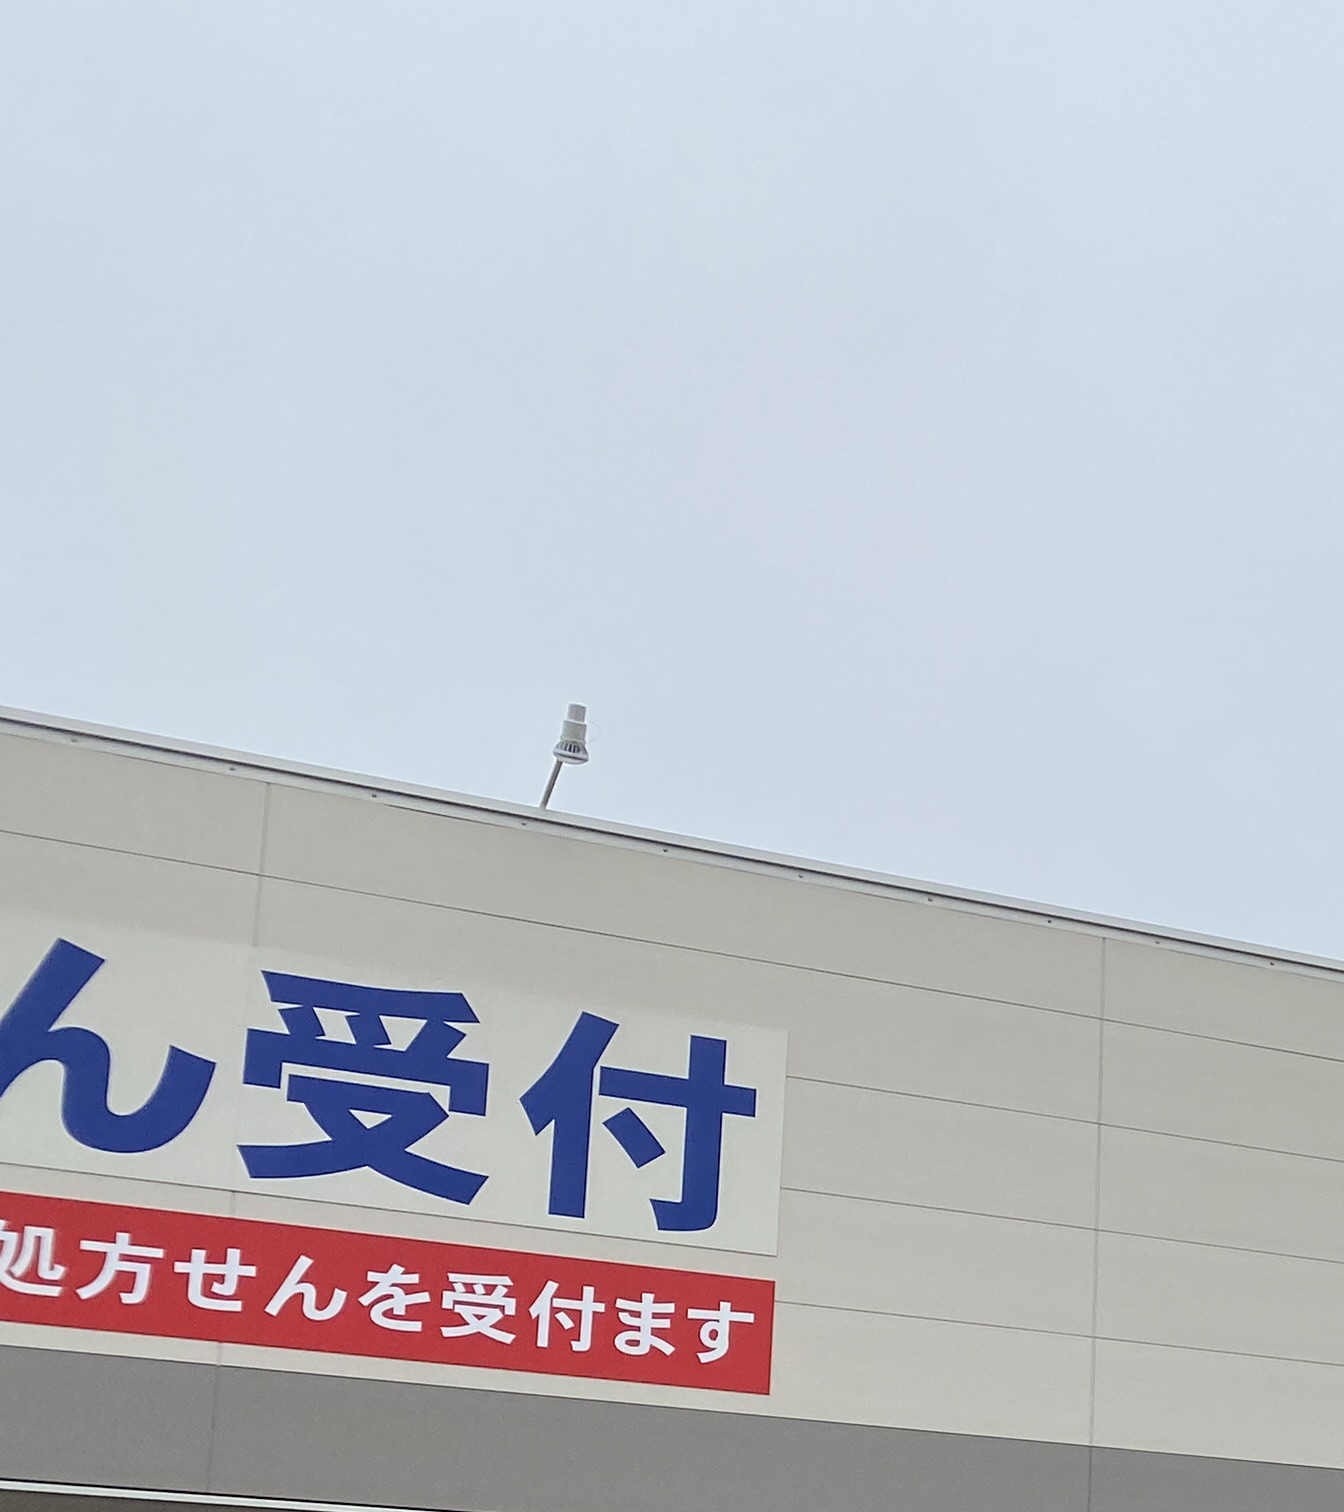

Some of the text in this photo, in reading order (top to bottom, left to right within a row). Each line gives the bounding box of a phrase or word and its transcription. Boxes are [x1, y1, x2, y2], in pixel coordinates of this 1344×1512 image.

[0, 1220, 755, 1363] 処方せんを受付ます
